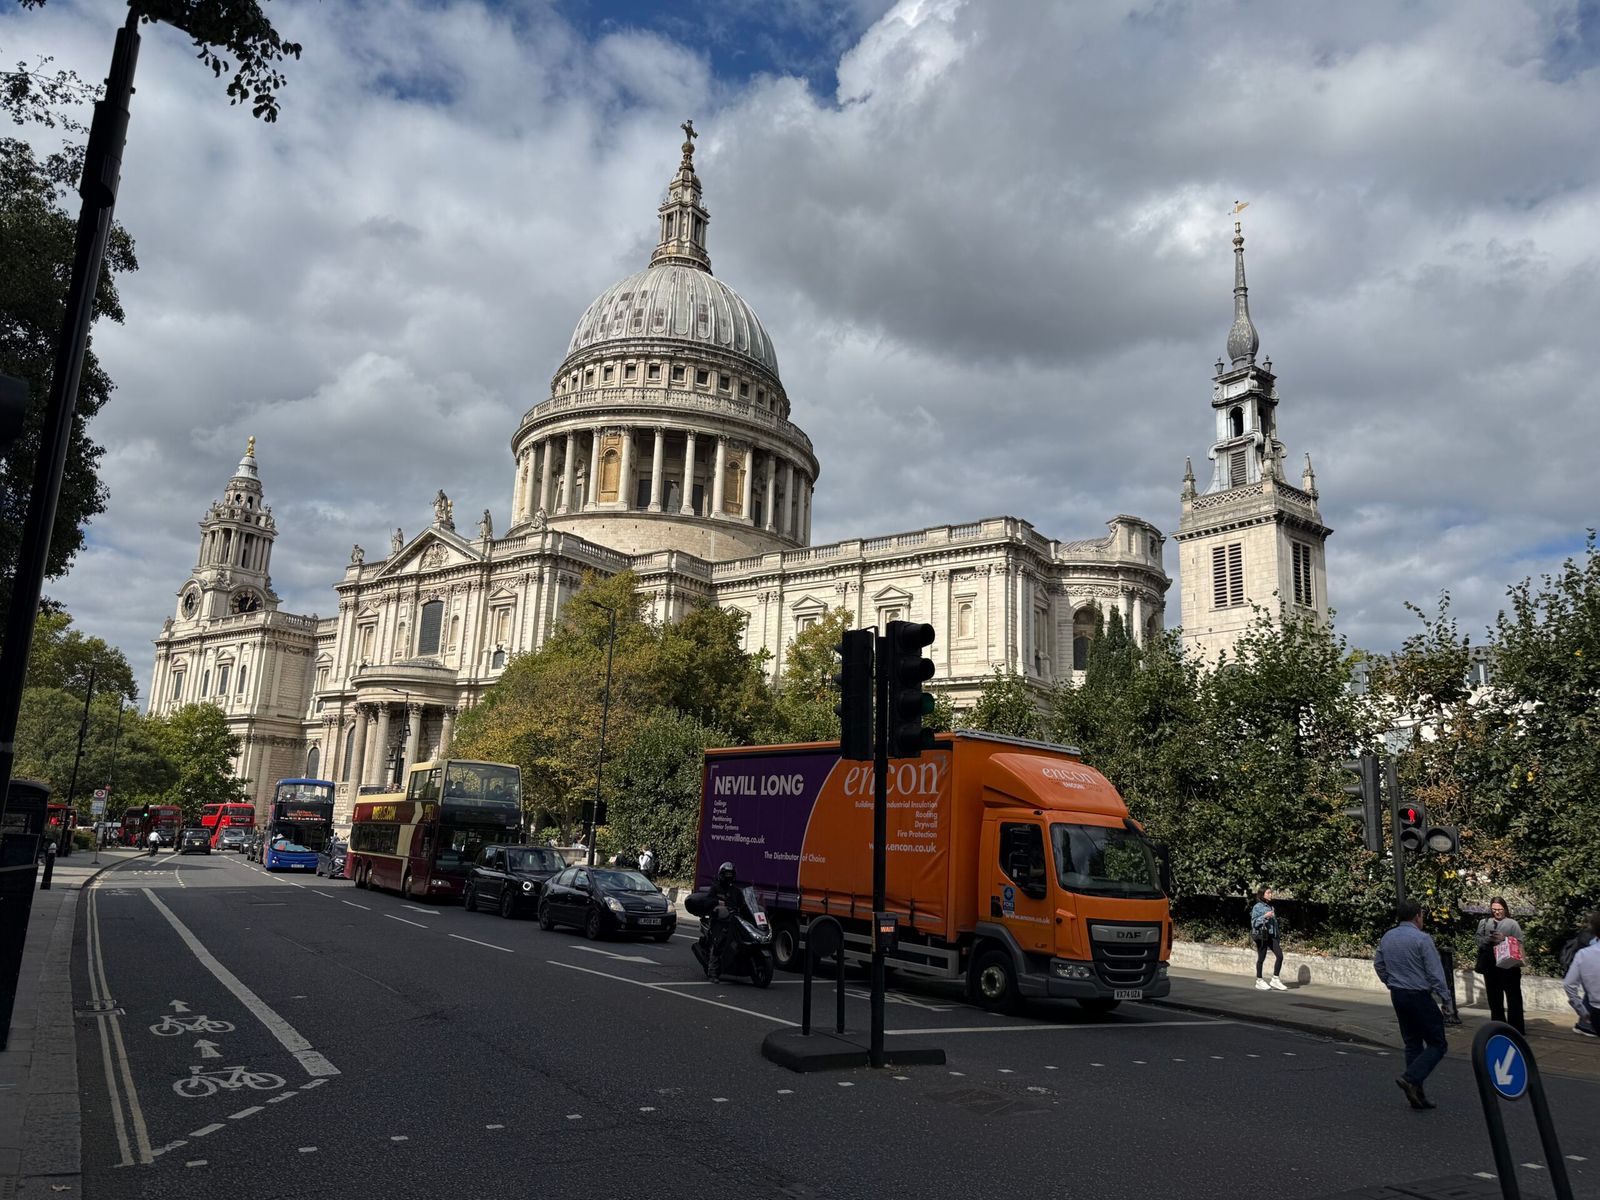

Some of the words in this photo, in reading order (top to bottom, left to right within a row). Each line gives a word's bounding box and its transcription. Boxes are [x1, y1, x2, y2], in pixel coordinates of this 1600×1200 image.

[844, 762, 939, 796] encon
[1042, 767, 1097, 785] encon
[714, 776, 756, 795] NEVILL
[760, 774, 804, 796] LONG
[886, 800, 910, 809] ndustrial
[915, 810, 938, 820] Roofing
[914, 821, 937, 830] Drywall
[897, 829, 908, 838] Fire
[764, 851, 773, 859] The
[773, 852, 799, 861] Distributor
[802, 853, 808, 862] of
[808, 854, 826, 864] Choice
[1116, 931, 1142, 939] DAF
